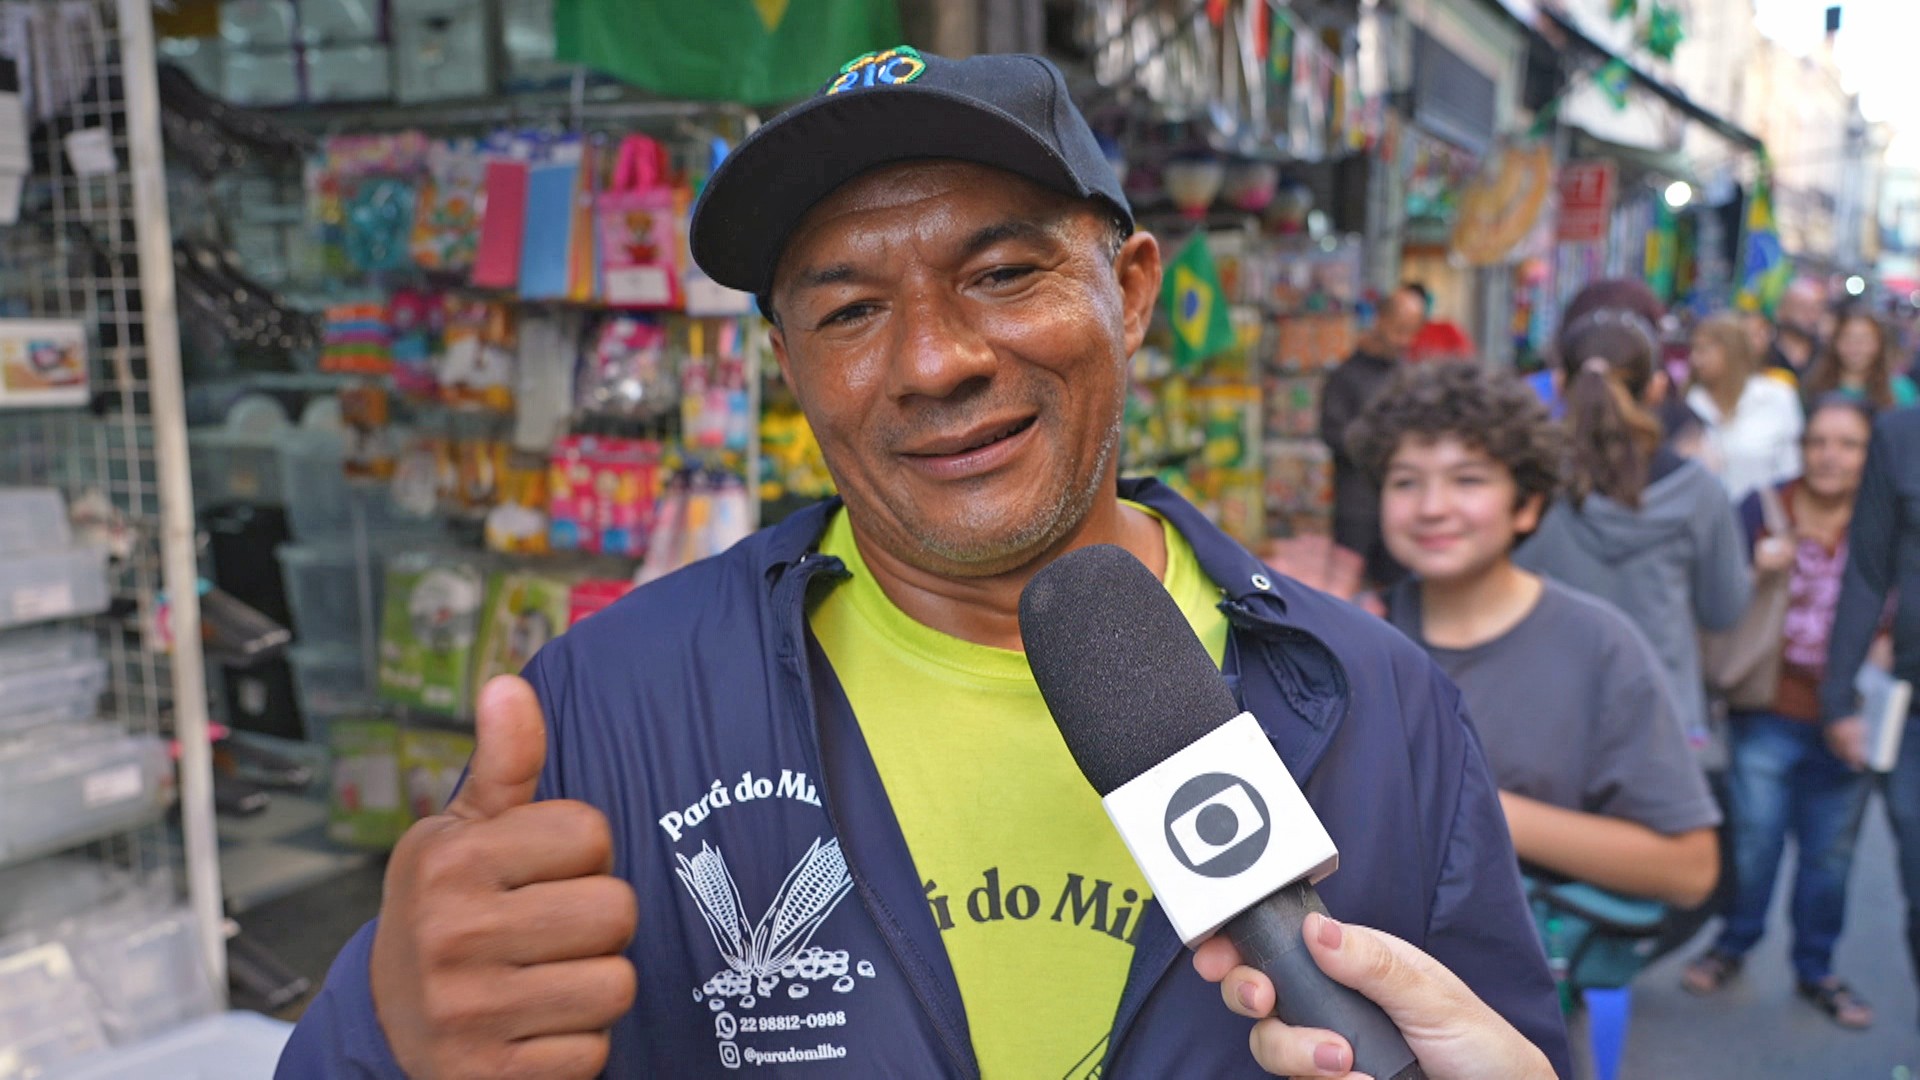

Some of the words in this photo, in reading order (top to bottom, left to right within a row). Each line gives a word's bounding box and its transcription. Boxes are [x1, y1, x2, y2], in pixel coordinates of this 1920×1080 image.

[659, 779, 731, 842] Pará
[735, 771, 773, 802] do
[776, 769, 822, 808] Mi
[967, 866, 1041, 923] do
[740, 1017, 757, 1032] 22
[759, 1011, 846, 1031] 98812-0998
[744, 1043, 847, 1066] @paradomilho
